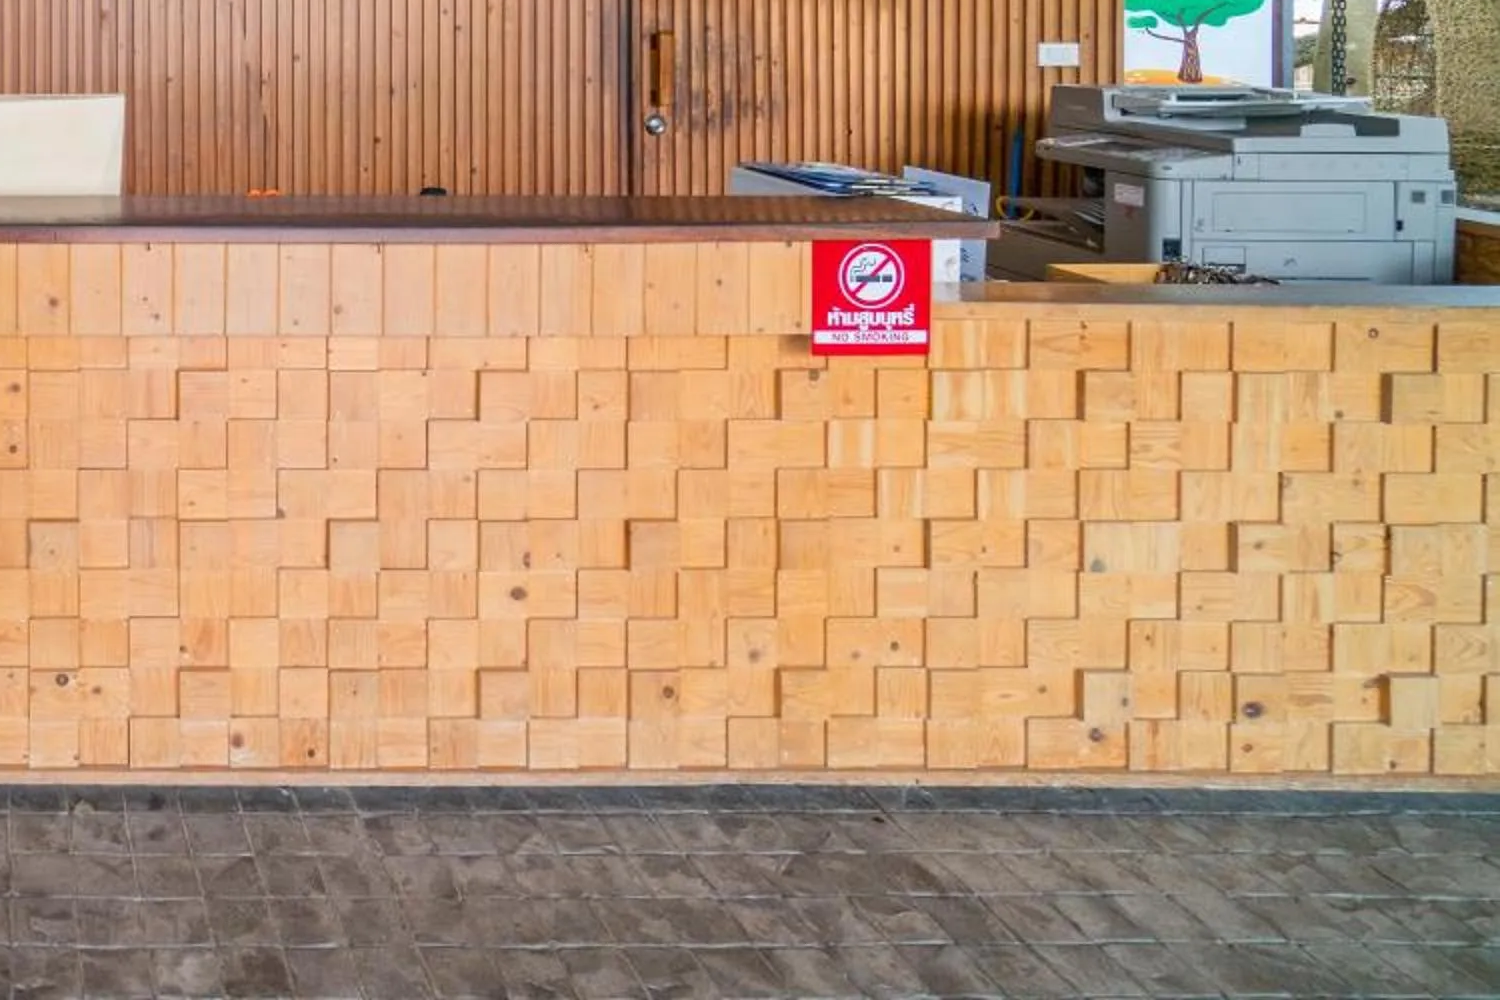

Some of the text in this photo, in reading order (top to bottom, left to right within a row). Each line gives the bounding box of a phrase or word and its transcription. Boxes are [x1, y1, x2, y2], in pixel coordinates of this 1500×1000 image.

[827, 303, 915, 331] ห้ามสูบบุหรี่
[832, 333, 909, 341] NO SMOKING
